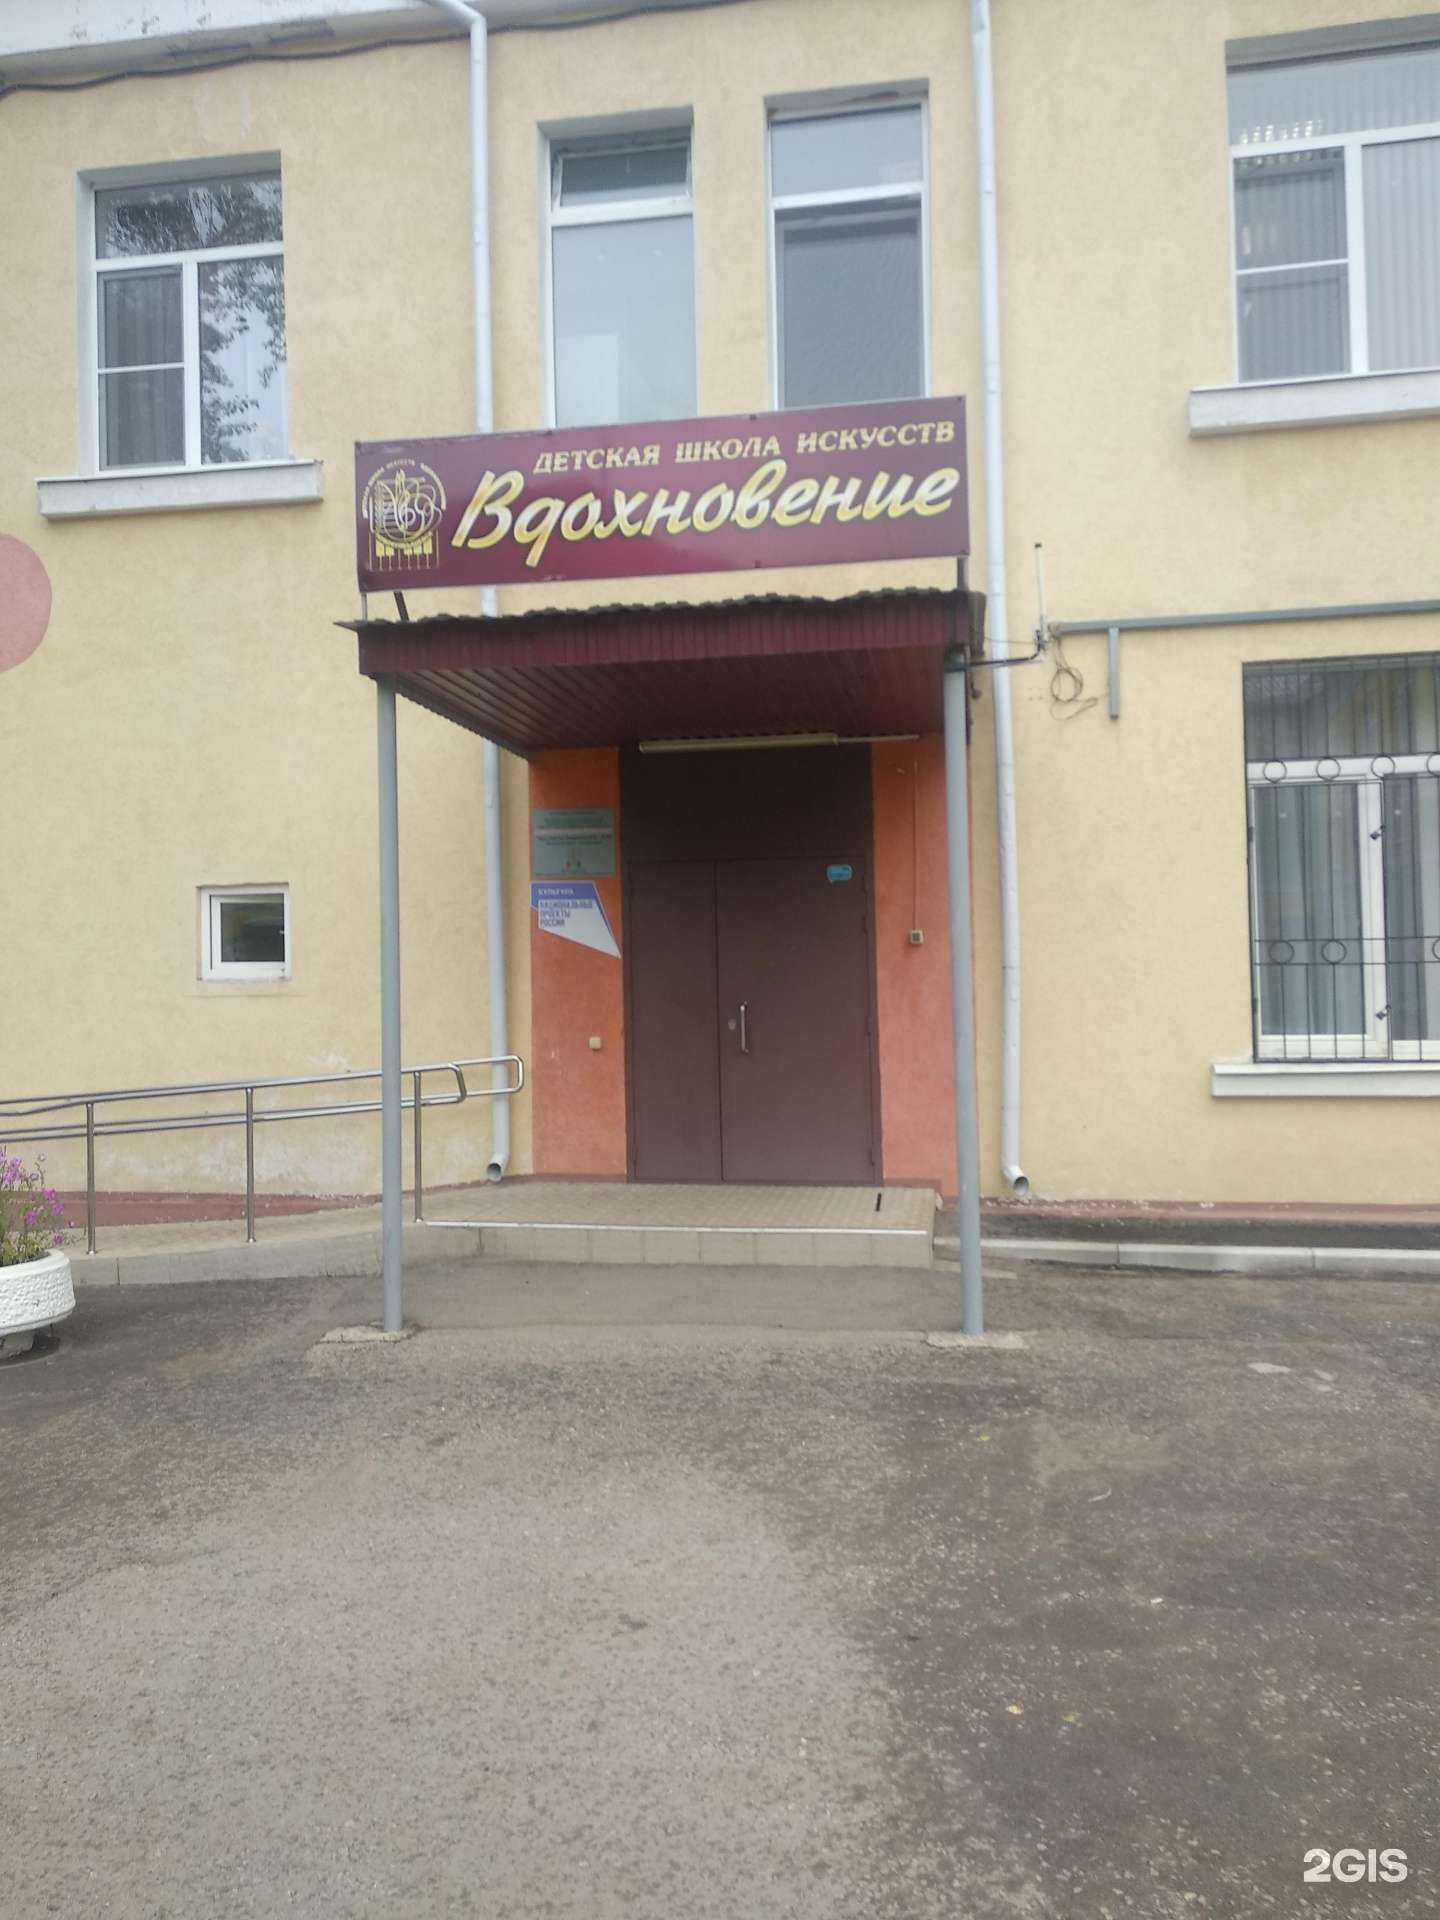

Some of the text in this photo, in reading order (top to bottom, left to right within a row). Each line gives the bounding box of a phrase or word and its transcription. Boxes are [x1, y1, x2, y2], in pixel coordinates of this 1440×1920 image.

[533, 420, 955, 474] ДЕТСКАЯ ШКОЛА ИСКУССТВ
[450, 459, 960, 568] Вдохновение
